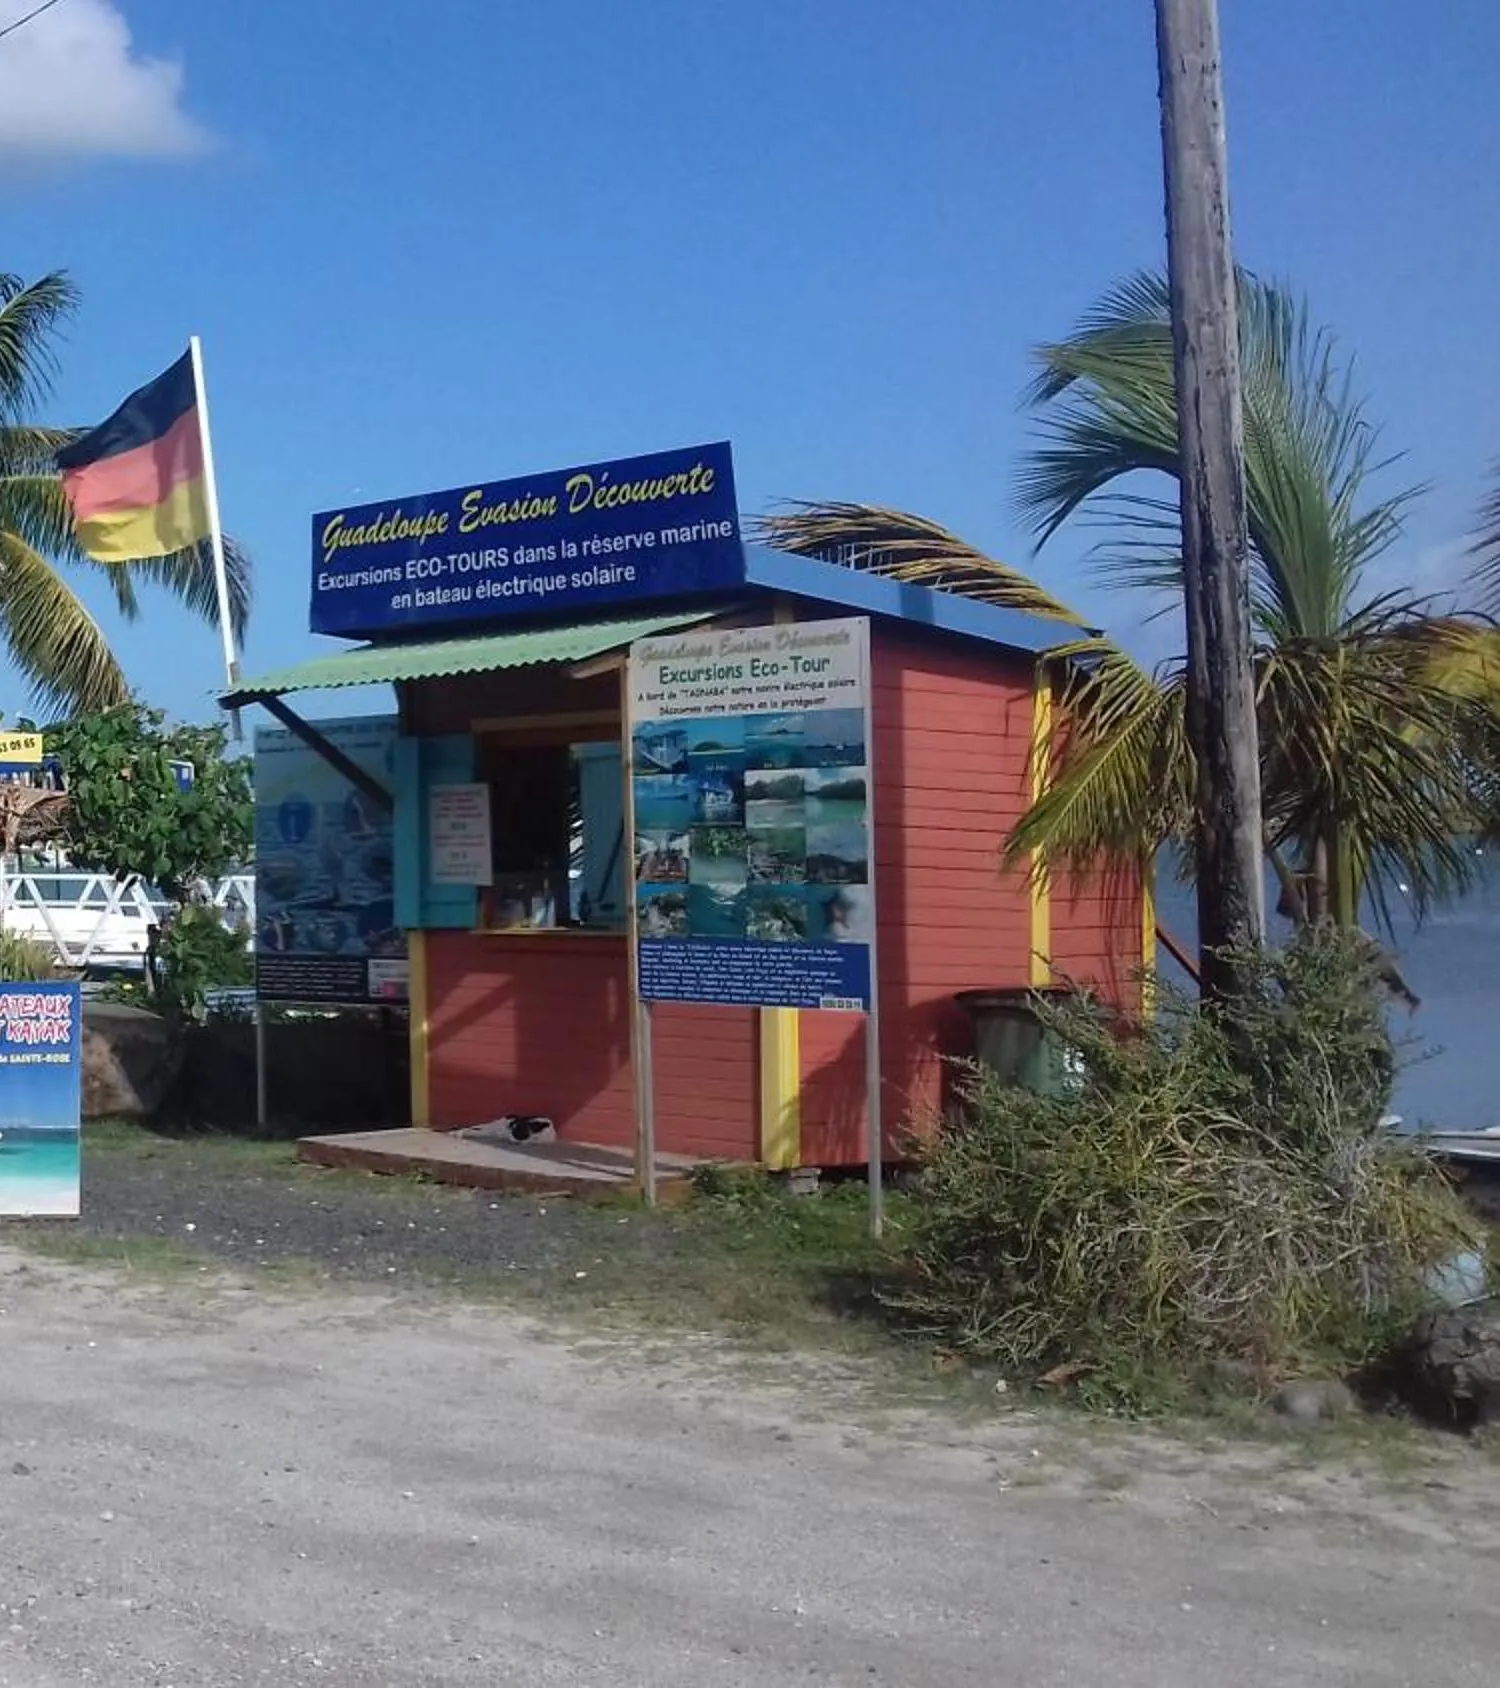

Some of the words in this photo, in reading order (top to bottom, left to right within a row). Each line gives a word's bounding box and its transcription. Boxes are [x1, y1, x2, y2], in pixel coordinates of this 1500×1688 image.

[322, 508, 449, 562] Guadeloupe
[459, 489, 558, 533] Evasion
[565, 463, 715, 513] Découverte
[318, 566, 401, 591] Excursions
[406, 548, 508, 579] ECO-TOURS
[513, 545, 557, 566] dans
[561, 539, 577, 559] la
[583, 533, 656, 555] réserve
[660, 520, 733, 545] marine
[391, 593, 411, 609] en
[415, 586, 471, 607] bateau
[475, 574, 567, 598] électrique
[571, 564, 636, 587] solaire
[660, 663, 742, 684] Excursions
[7, 1018, 71, 1044] KAYAK
